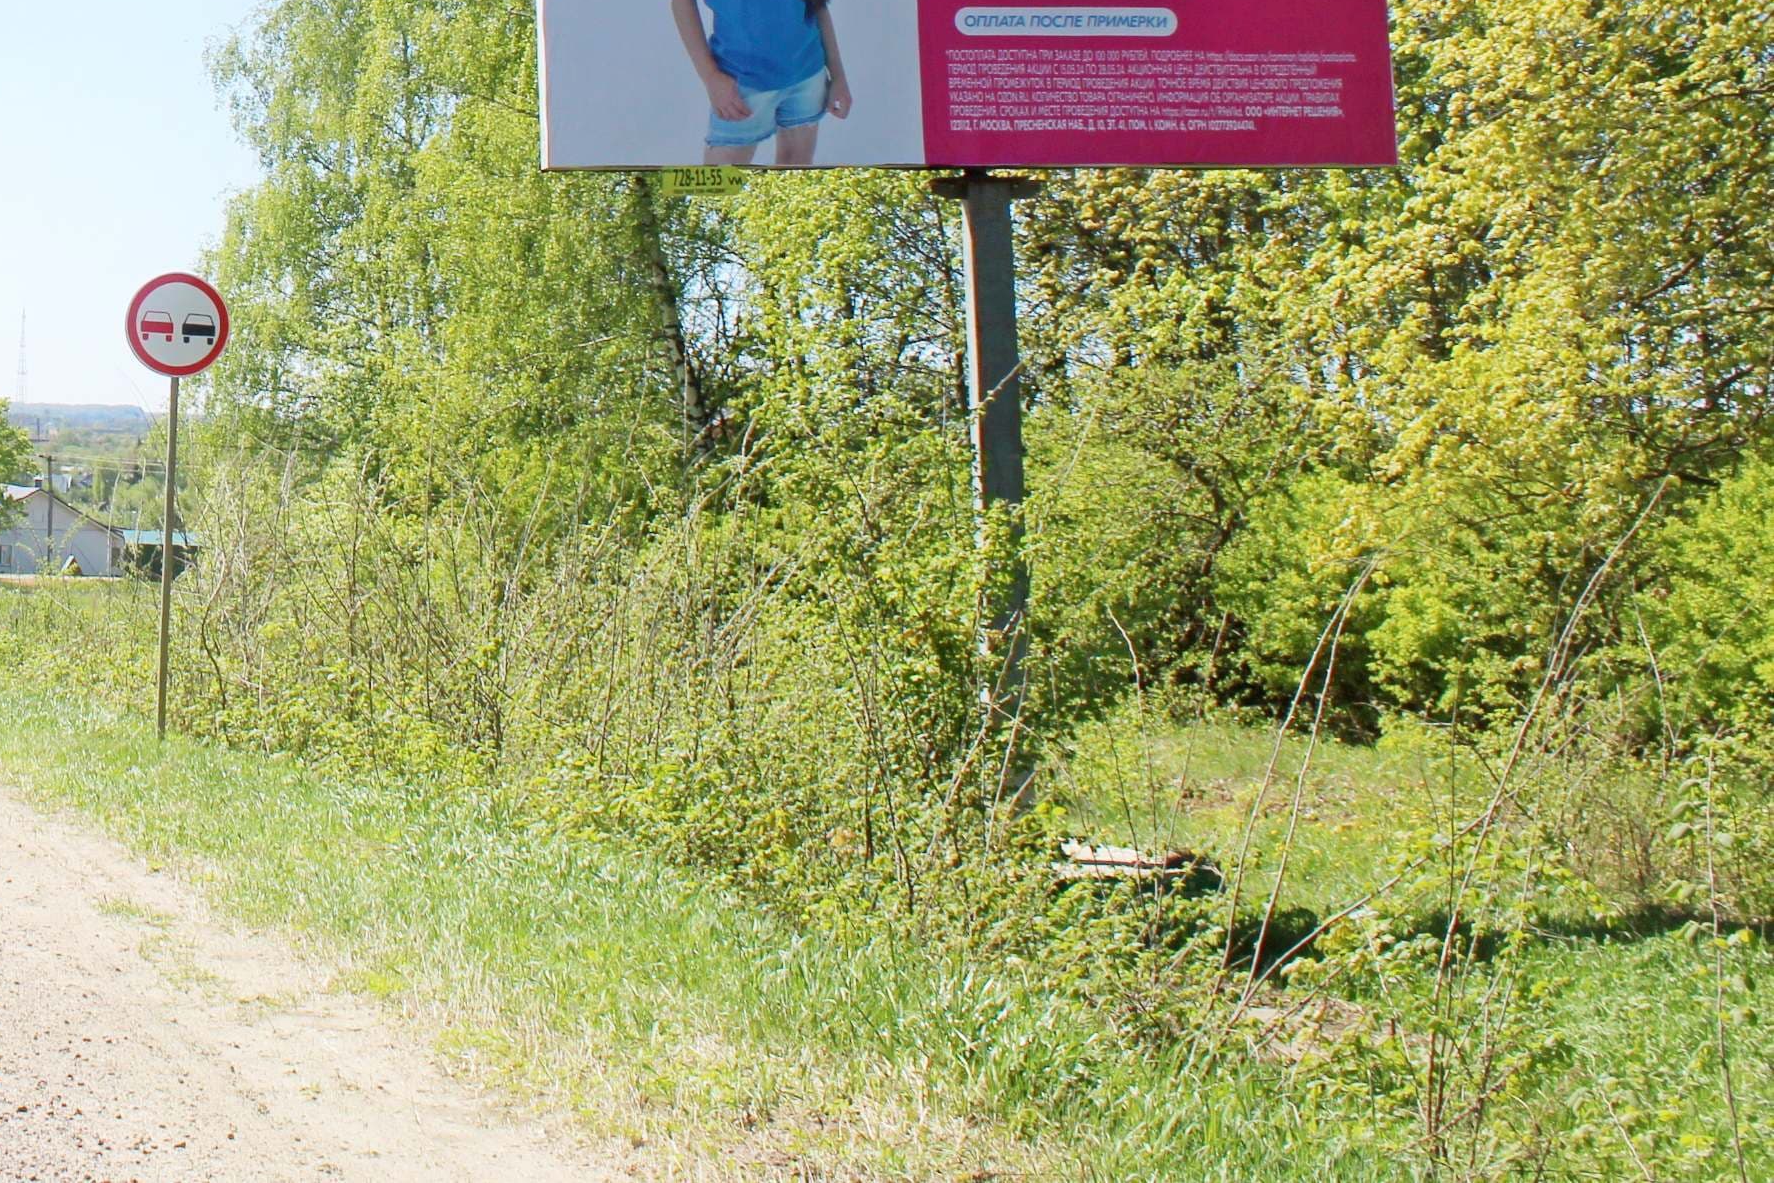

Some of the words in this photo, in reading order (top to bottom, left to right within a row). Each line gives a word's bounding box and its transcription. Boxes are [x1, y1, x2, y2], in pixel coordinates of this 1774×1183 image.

[963, 14, 1026, 28] ОПЛАТА
[1029, 14, 1083, 28] ПОСЛЕ
[1086, 14, 1168, 28] ПРИМЕРКИ
[673, 168, 723, 187] 728-11-55
